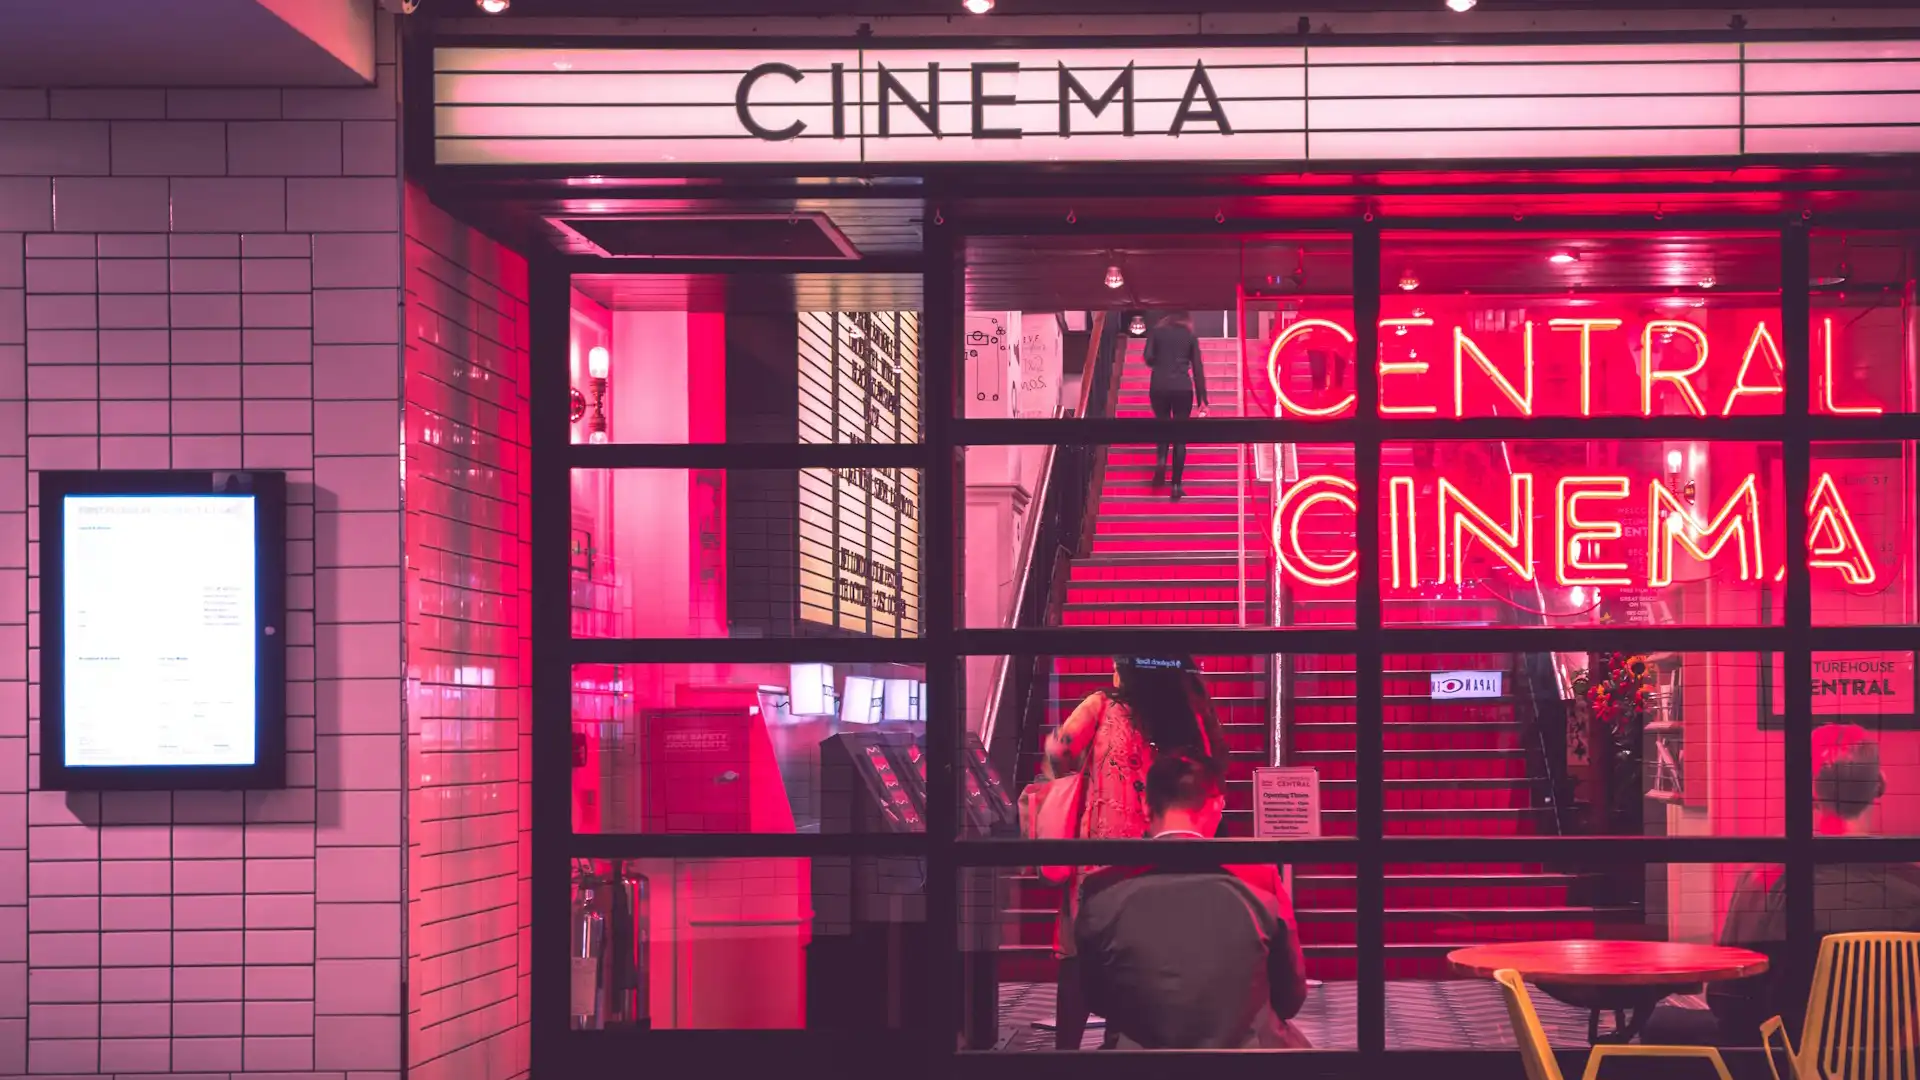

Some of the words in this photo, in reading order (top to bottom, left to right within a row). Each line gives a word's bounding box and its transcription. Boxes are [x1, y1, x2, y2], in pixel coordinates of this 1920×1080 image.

[735, 58, 1234, 141] CINEMA
[1267, 317, 1883, 417] CENTRAL
[1272, 473, 1876, 588] CINEMA
